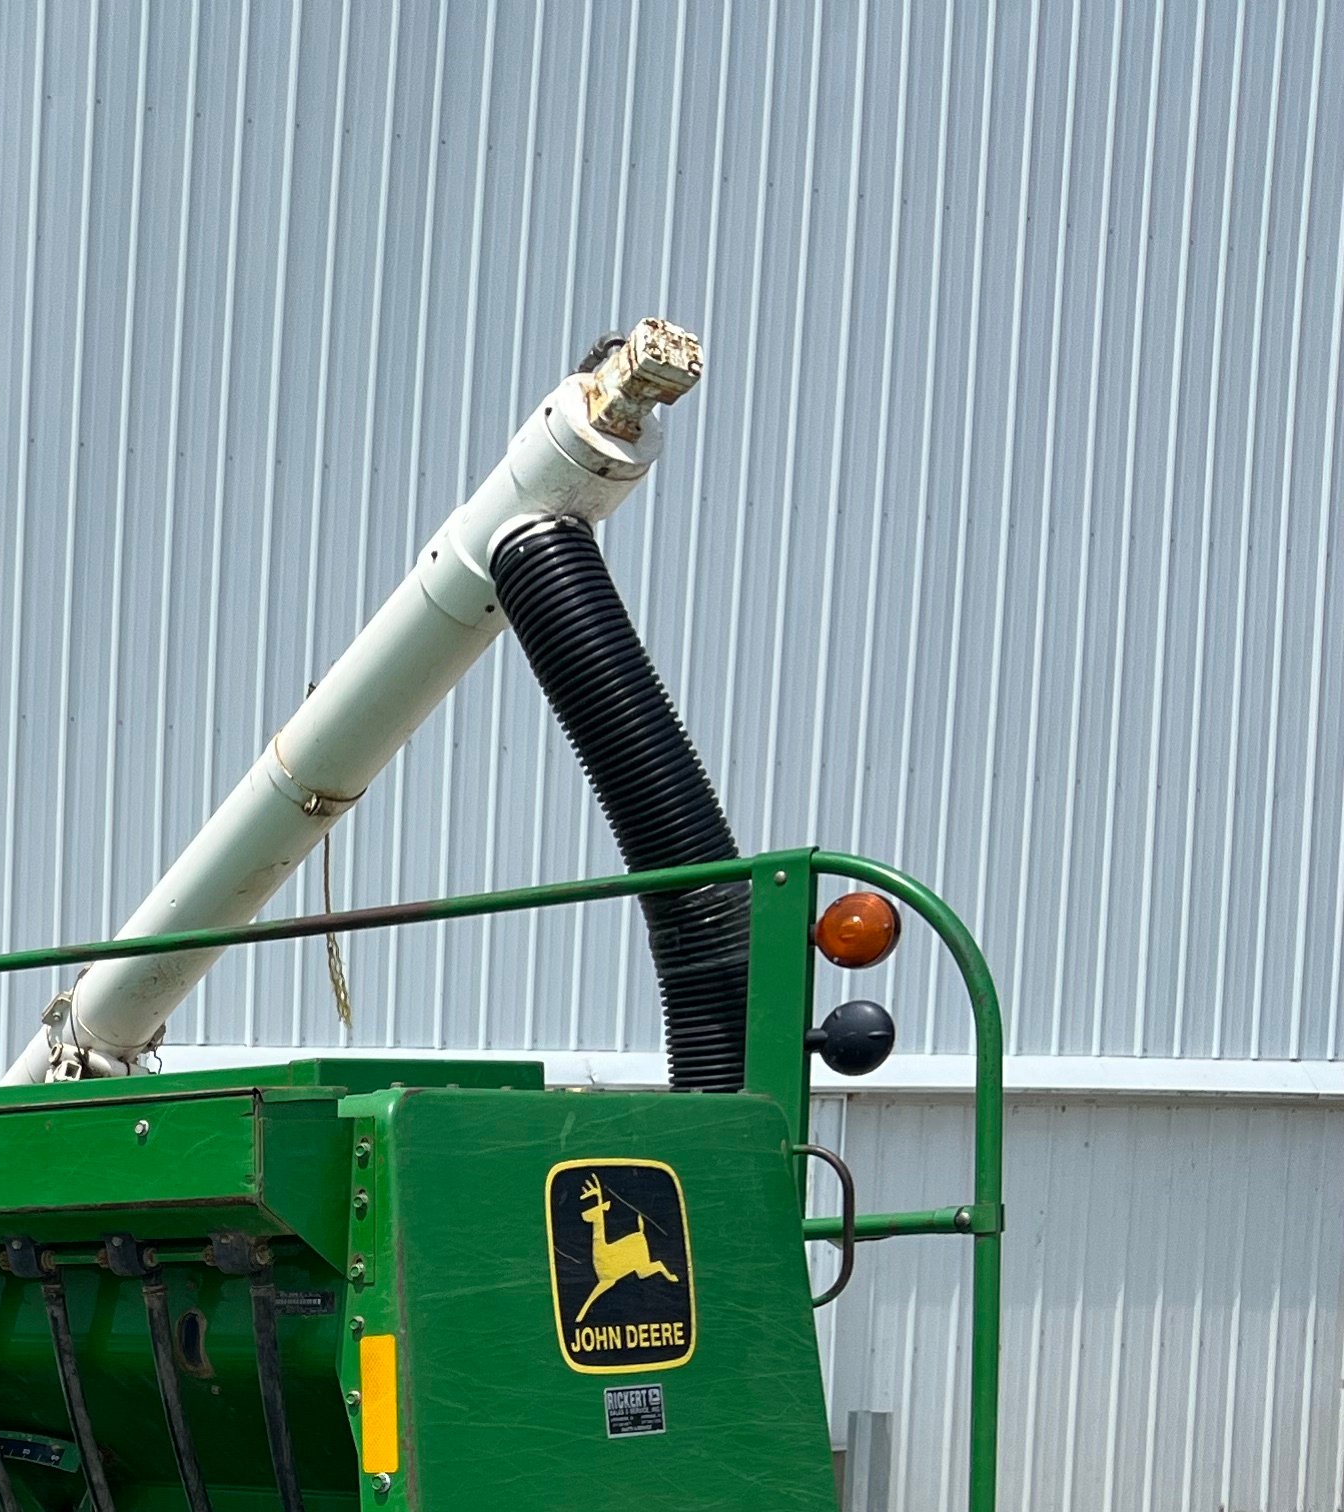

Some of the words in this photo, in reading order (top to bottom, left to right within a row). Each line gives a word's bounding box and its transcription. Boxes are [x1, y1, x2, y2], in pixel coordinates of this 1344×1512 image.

[571, 1325, 622, 1353] JOHN
[626, 1322, 685, 1349] DEERE
[607, 1390, 647, 1409] RICKERT
